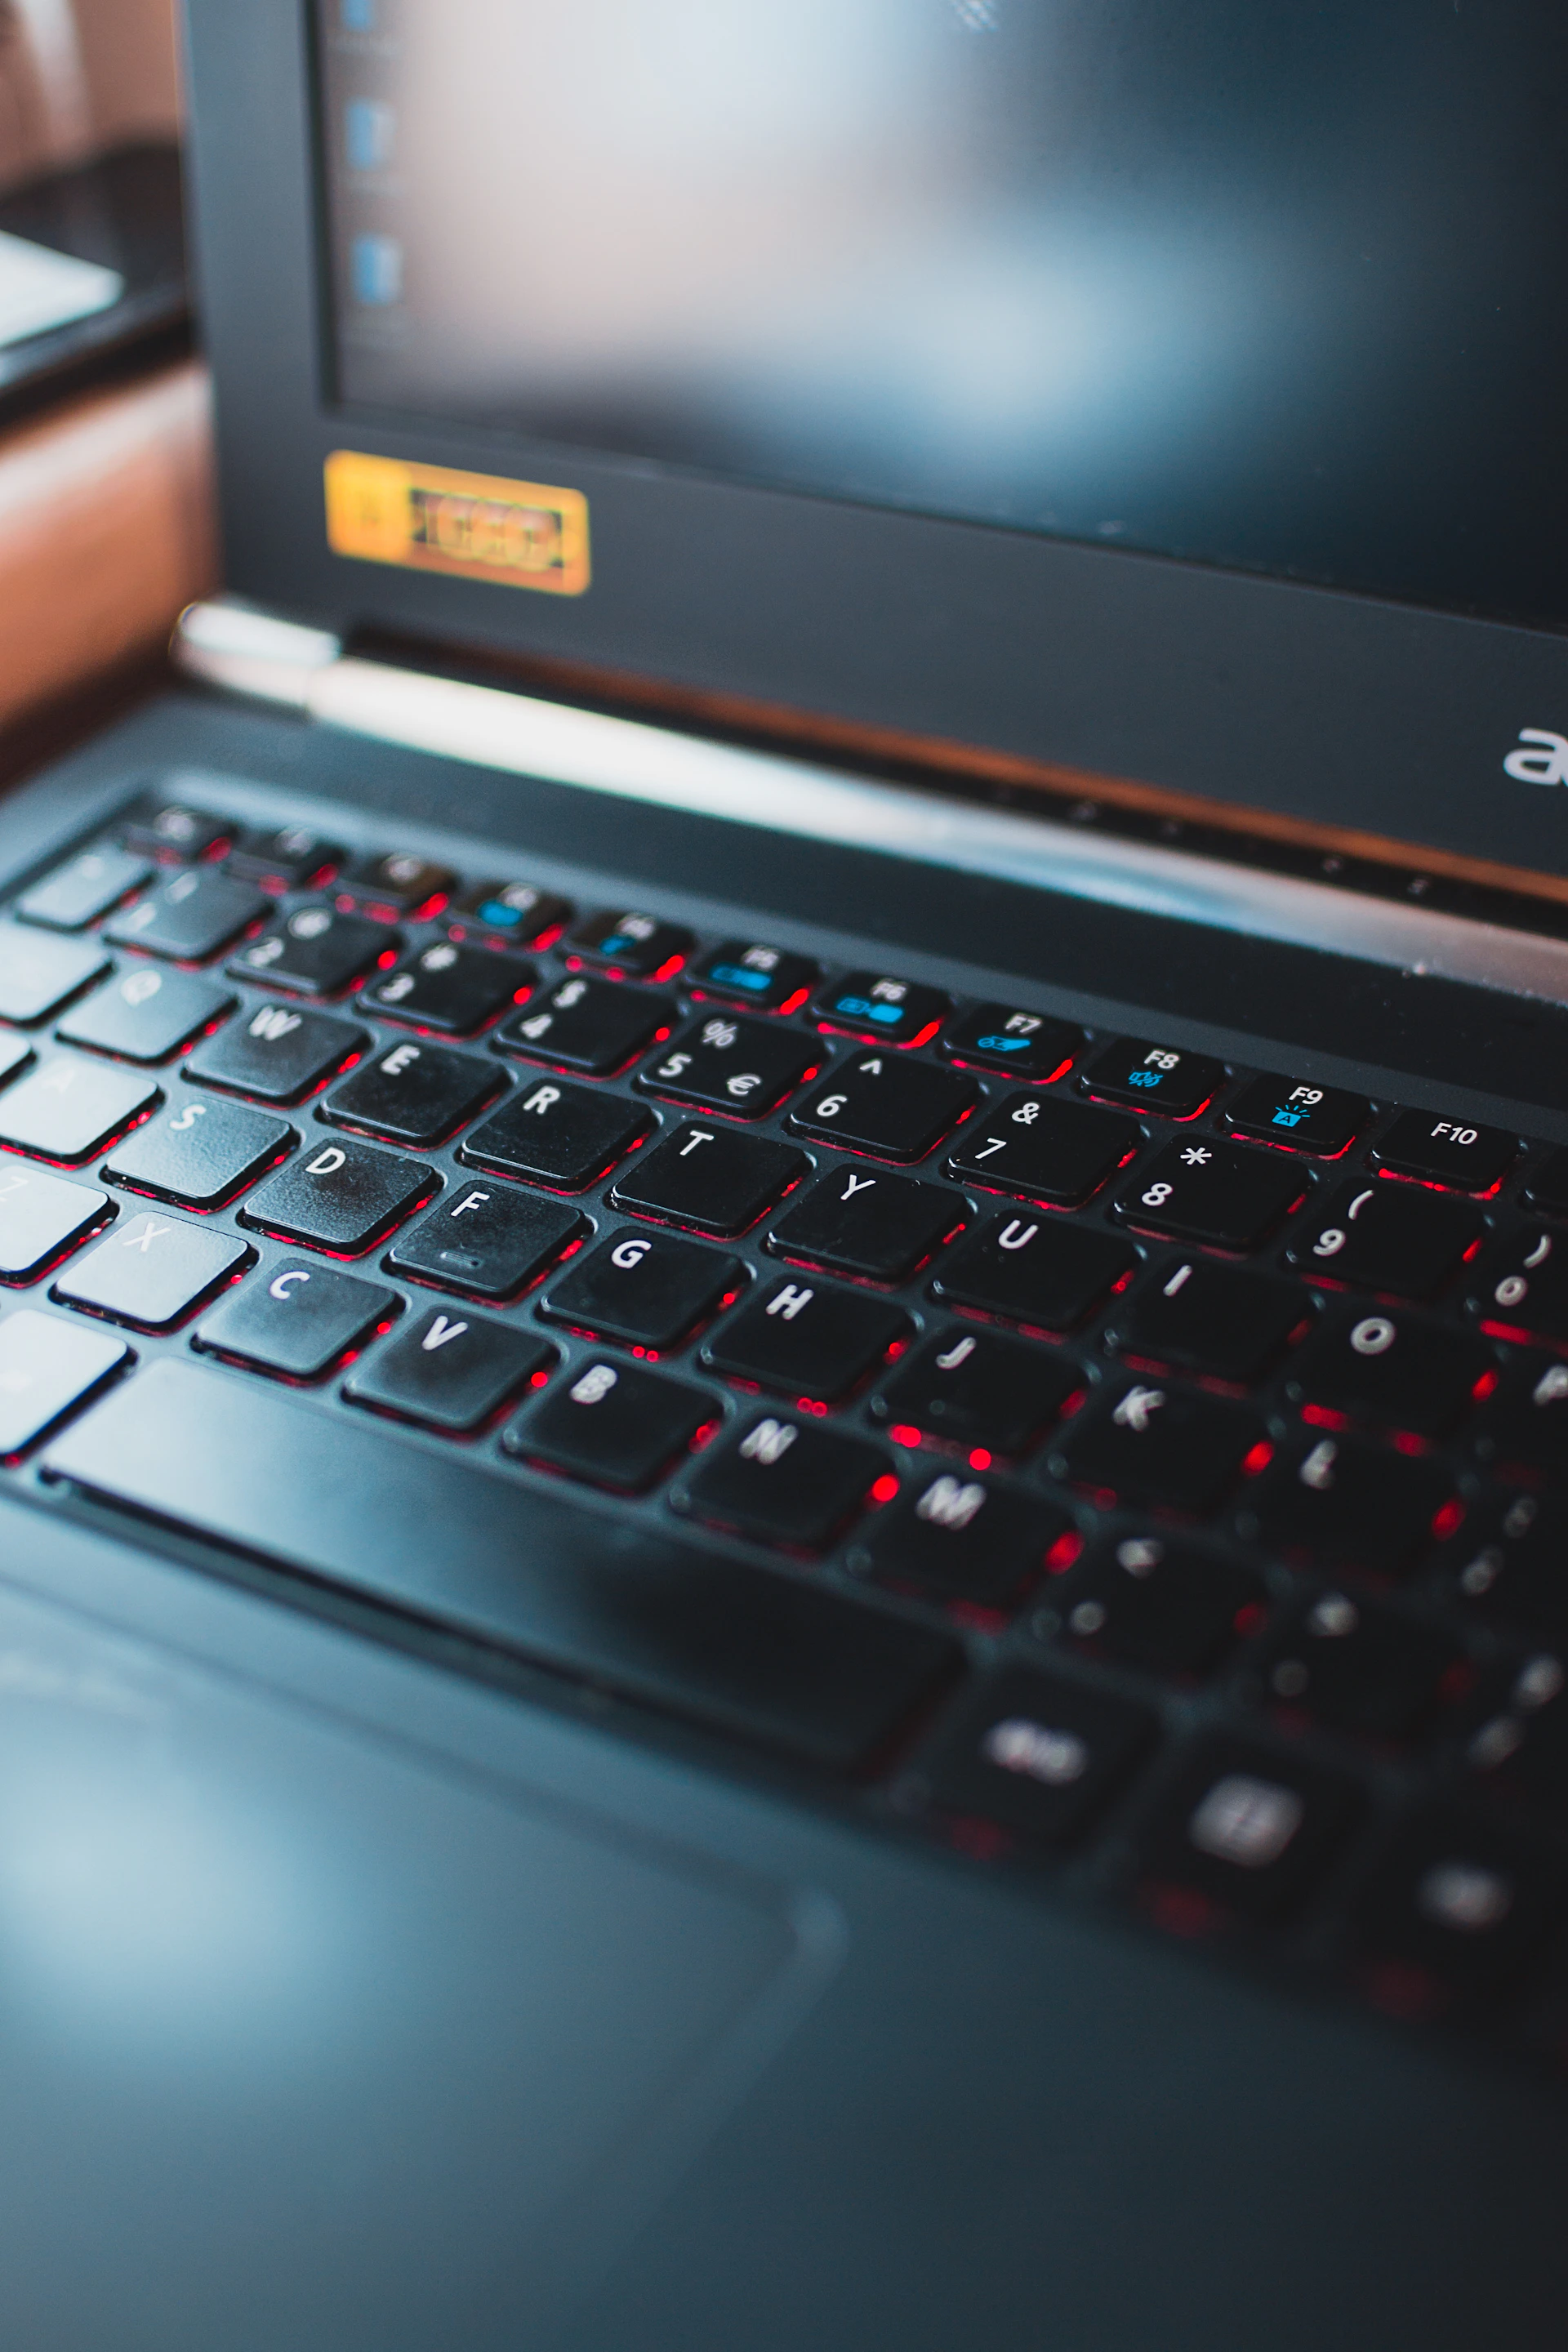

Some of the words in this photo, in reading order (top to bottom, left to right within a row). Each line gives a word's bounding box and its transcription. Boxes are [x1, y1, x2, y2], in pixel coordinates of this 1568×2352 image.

[1503, 726, 1568, 787] a
[381, 975, 414, 1001] 3
[872, 980, 906, 1001] F6
[249, 1006, 301, 1040] W
[521, 1014, 552, 1039] 4
[702, 1021, 737, 1048] %
[1004, 1013, 1041, 1034] F7
[381, 1045, 421, 1075] E
[658, 1054, 692, 1077] 5
[1143, 1049, 1180, 1070] F8
[727, 1074, 761, 1096] €
[1289, 1086, 1324, 1105] F9
[523, 1085, 561, 1115] R
[816, 1094, 848, 1117] 6
[1011, 1102, 1040, 1125] &
[169, 1104, 207, 1131] S
[679, 1129, 715, 1156] T
[1430, 1122, 1478, 1145] F10
[305, 1147, 346, 1174] D
[974, 1138, 1007, 1160] 7
[840, 1174, 876, 1200] Y
[1141, 1183, 1173, 1206] 8
[450, 1191, 490, 1217] F
[122, 1222, 172, 1253] X
[998, 1219, 1038, 1250] U
[1313, 1229, 1345, 1255] 9
[611, 1240, 652, 1268] G
[269, 1271, 310, 1300] C
[766, 1285, 813, 1320] H
[422, 1316, 468, 1351] V
[1351, 1317, 1394, 1353] O
[936, 1336, 977, 1370] J
[571, 1365, 617, 1403] B
[1112, 1386, 1165, 1429] K
[739, 1418, 798, 1464] N
[916, 1476, 986, 1530] M
